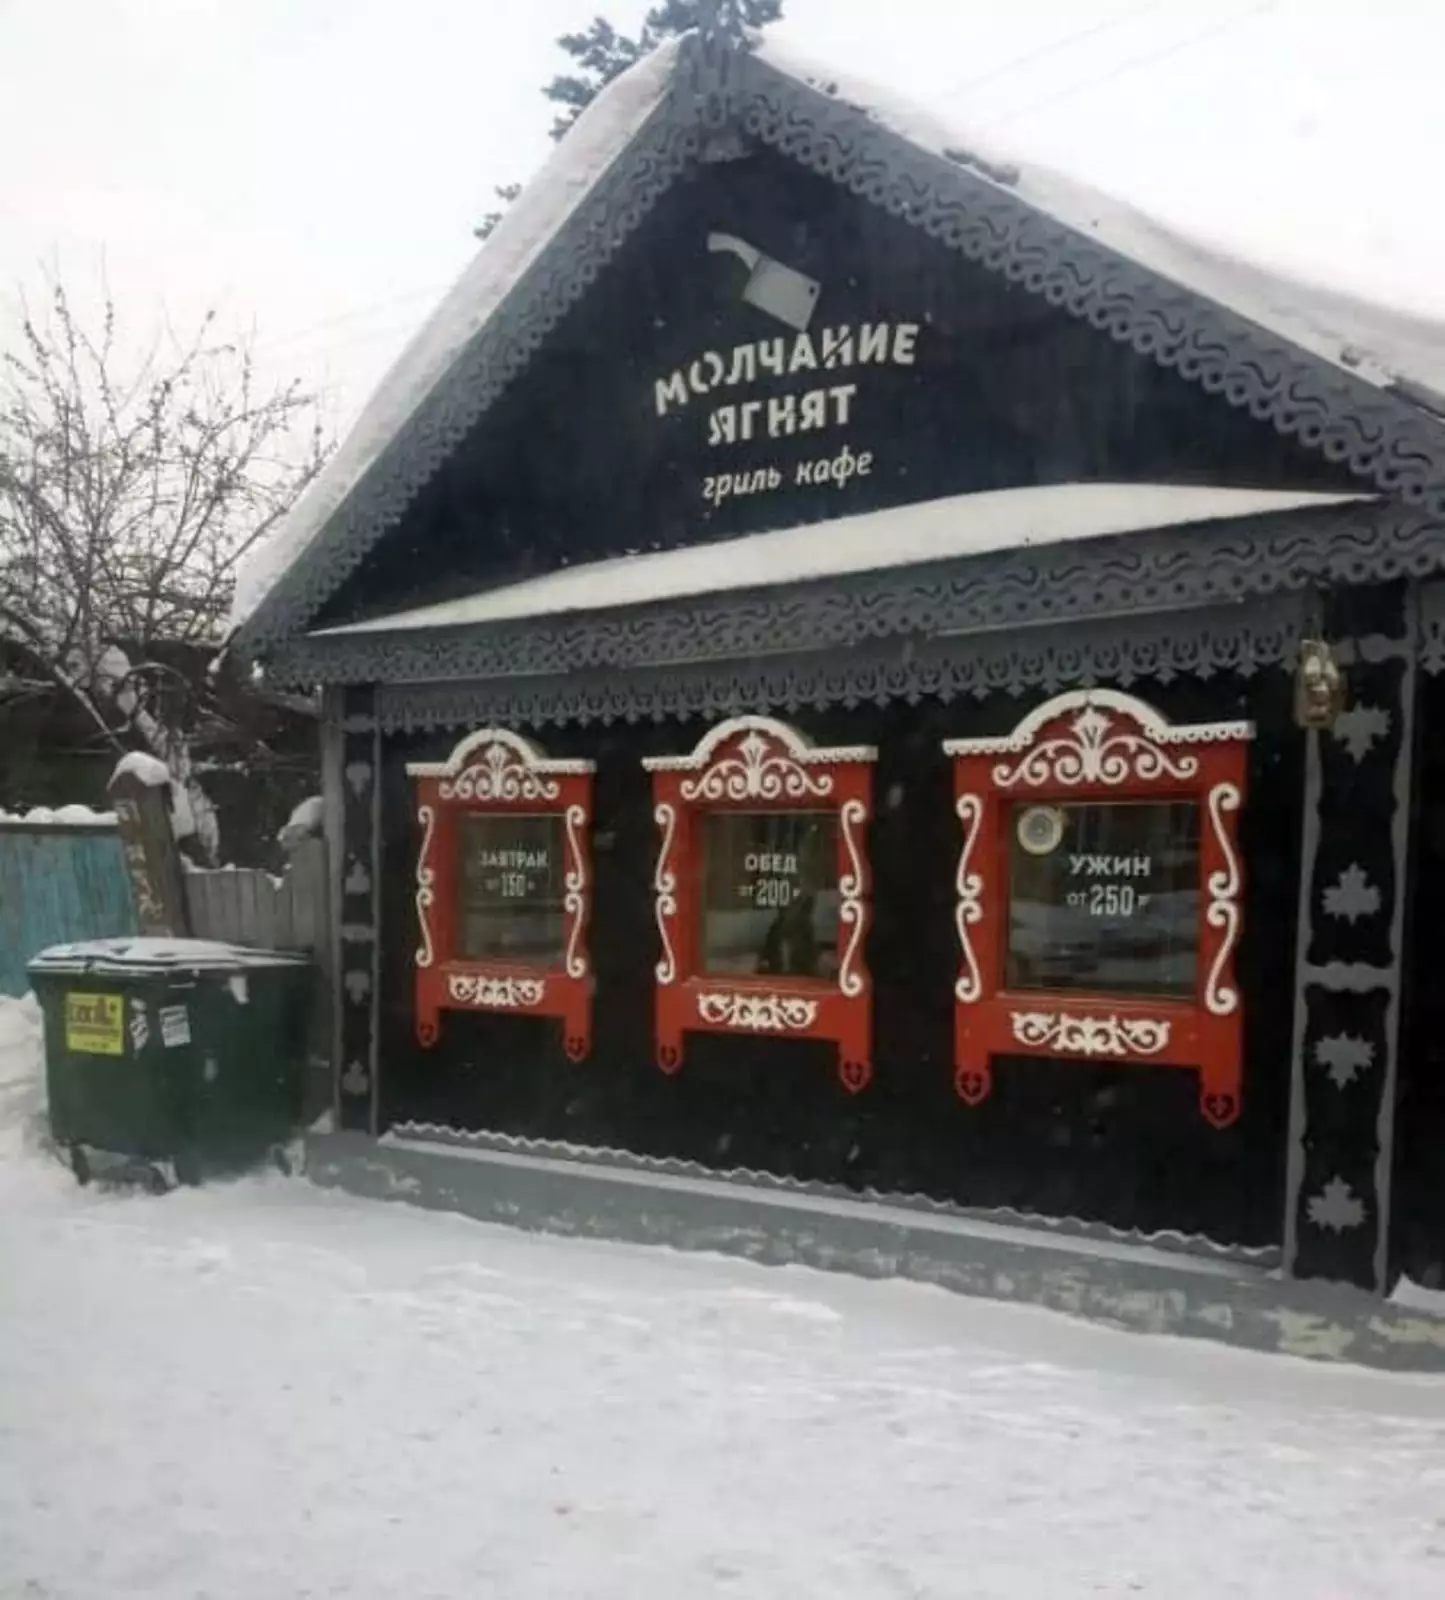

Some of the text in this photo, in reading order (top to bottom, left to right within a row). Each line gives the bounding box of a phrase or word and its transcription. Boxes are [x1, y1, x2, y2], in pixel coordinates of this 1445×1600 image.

[655, 323, 919, 415] МОЛЧАНИЕ
[708, 384, 856, 445] ЯГНЯТ
[703, 445, 873, 507] гриль кафе
[744, 853, 797, 873] ОБЕД
[1069, 855, 1151, 876] УЖИН
[756, 878, 790, 906] 200
[1090, 884, 1134, 916] 250
